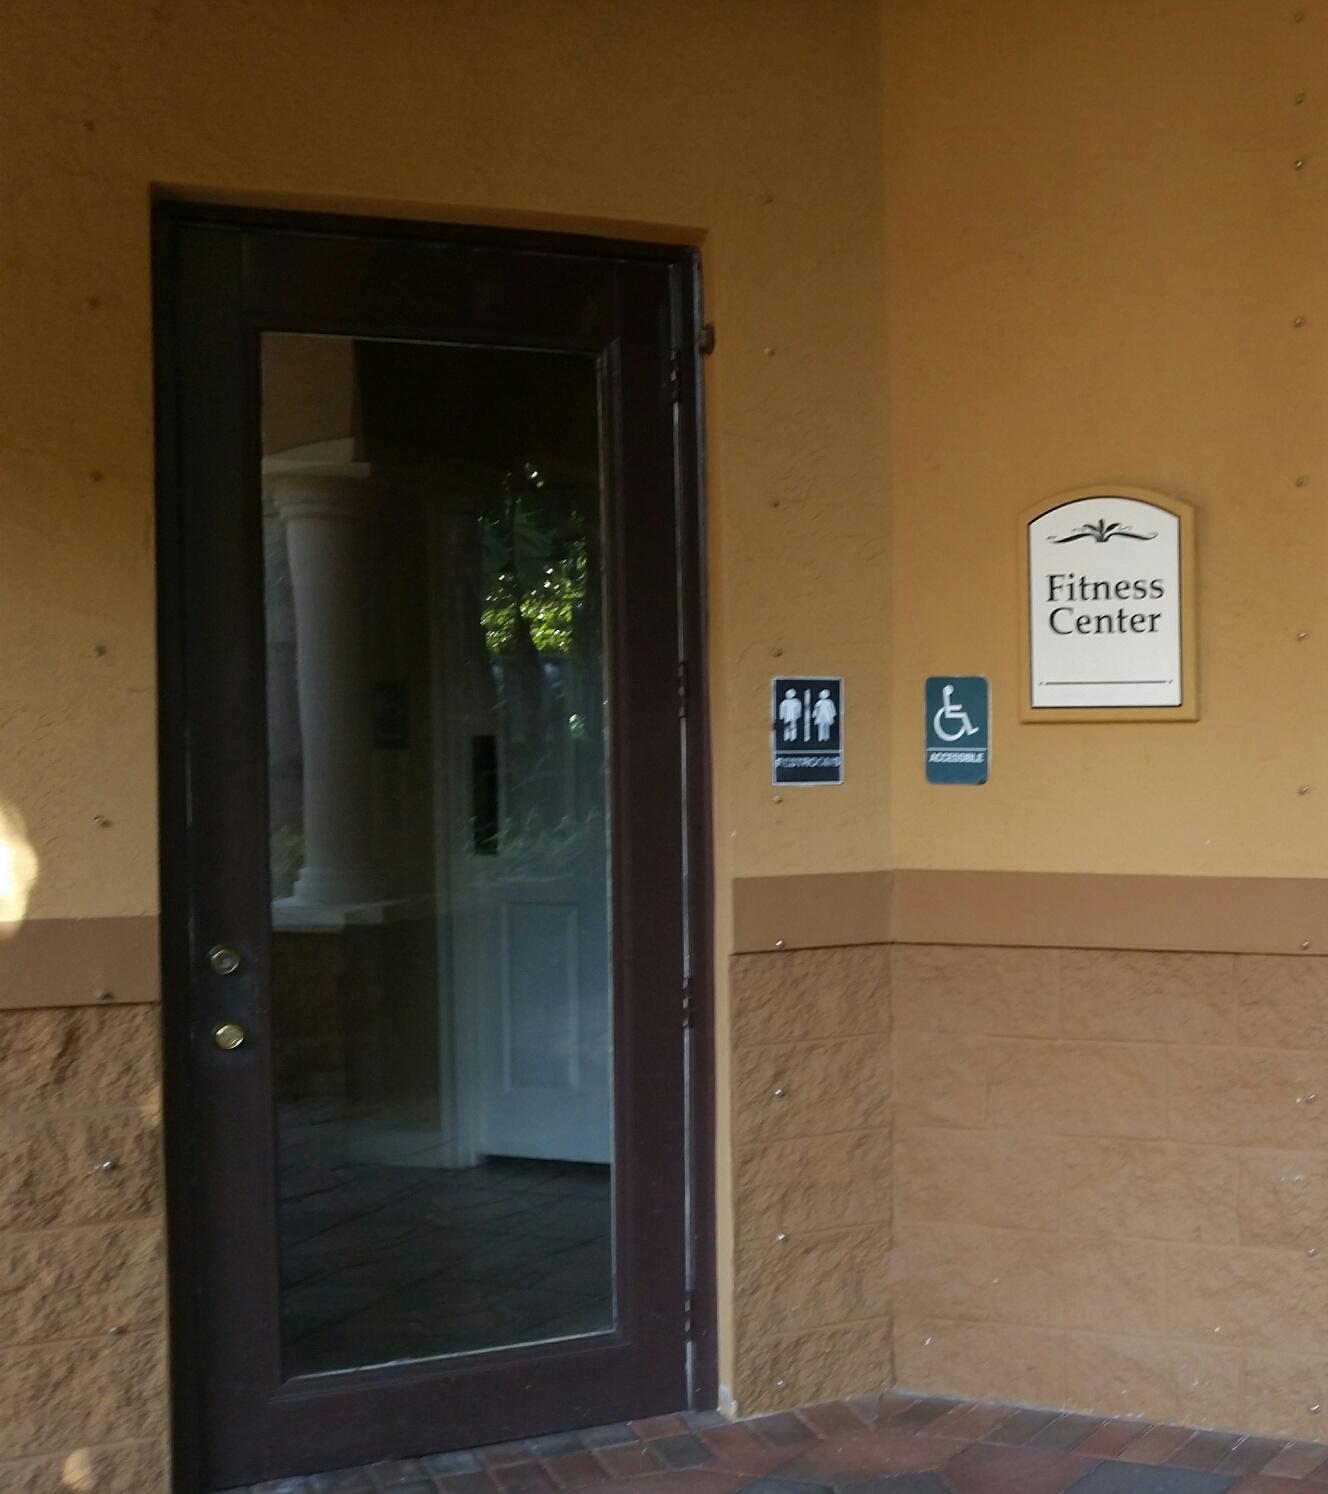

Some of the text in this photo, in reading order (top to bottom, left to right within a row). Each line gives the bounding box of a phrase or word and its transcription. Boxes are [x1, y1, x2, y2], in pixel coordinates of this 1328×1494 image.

[1045, 572, 1165, 602] Fitness
[1048, 606, 1162, 635] Center
[928, 752, 985, 763] ACCESSIBLE
